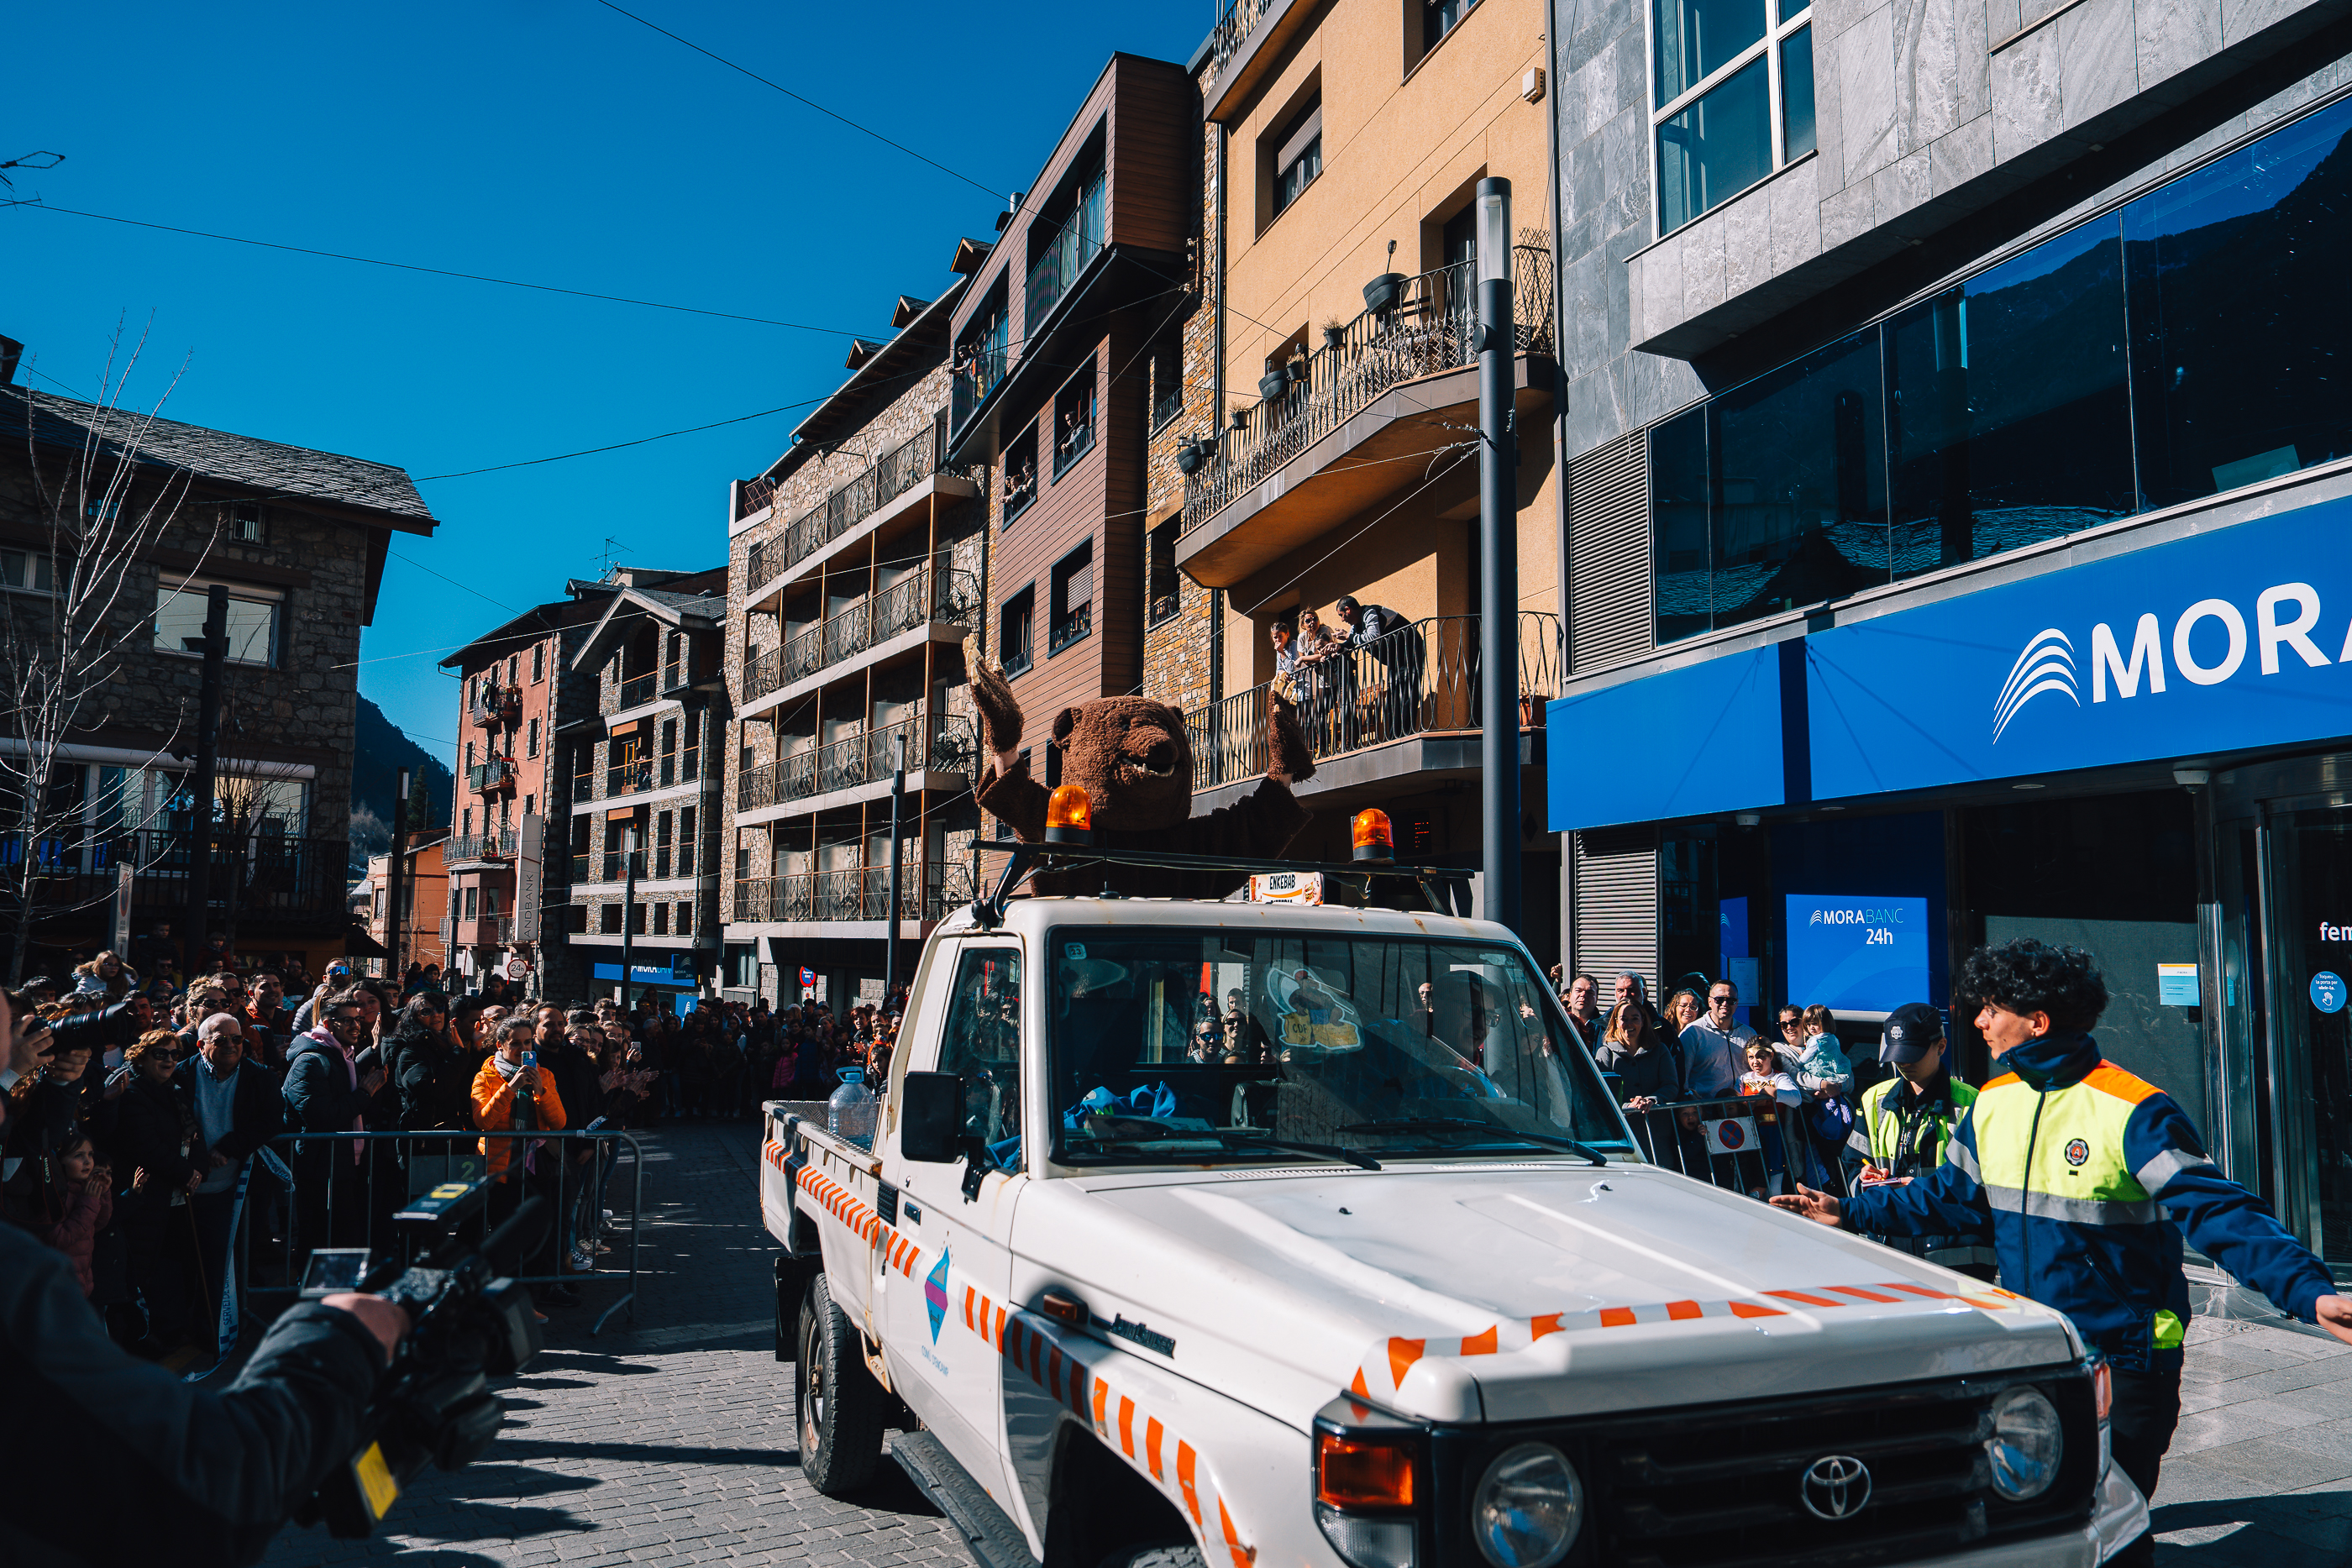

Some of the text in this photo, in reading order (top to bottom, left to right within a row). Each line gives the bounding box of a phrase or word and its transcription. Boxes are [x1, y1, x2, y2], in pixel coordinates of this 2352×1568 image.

[2092, 582, 2352, 704] MOR
[1269, 873, 1296, 890] ENKEBAB
[523, 874, 533, 938] ANDBANK
[1824, 908, 1903, 925] MORABANC
[1866, 927, 1893, 945] 24h
[1070, 947, 1082, 956] 23
[510, 963, 525, 972] 24h
[1292, 1023, 1308, 1034] CDF
[460, 1161, 475, 1181] 2
[223, 1300, 232, 1326] SERVEI
